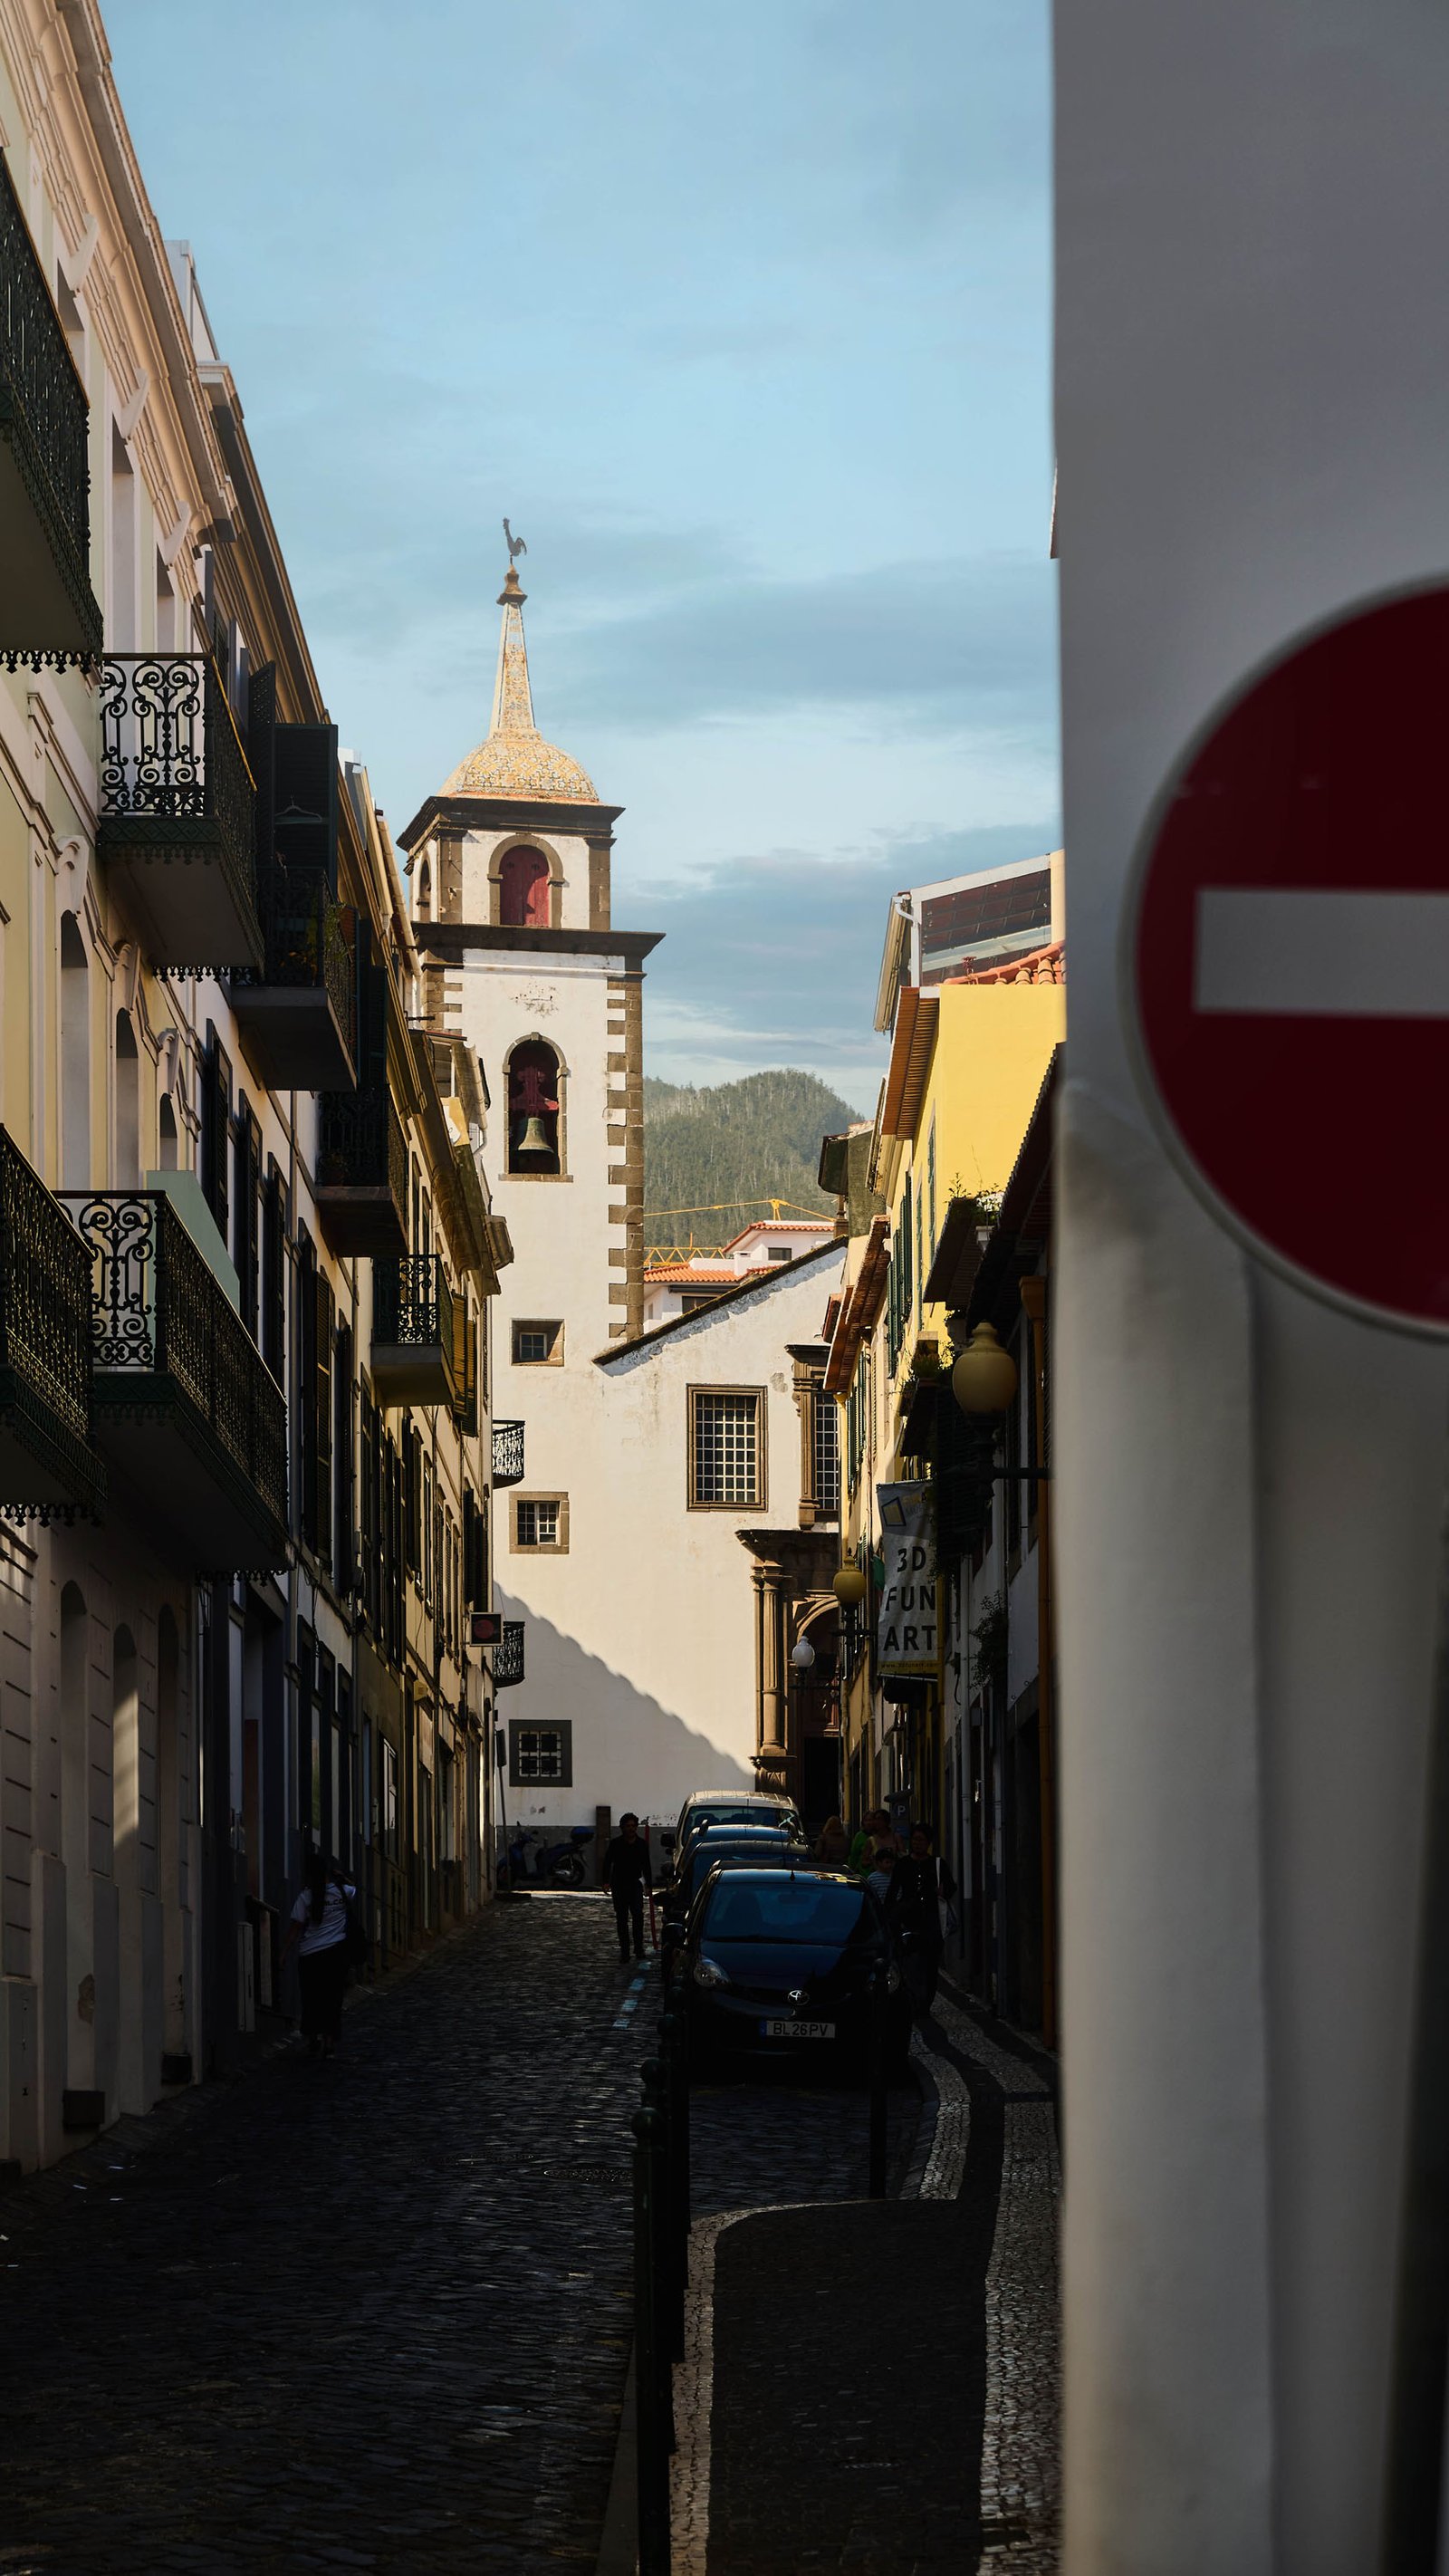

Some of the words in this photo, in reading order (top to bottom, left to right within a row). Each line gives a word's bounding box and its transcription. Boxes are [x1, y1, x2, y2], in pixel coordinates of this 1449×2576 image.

[897, 1546, 926, 1572] 3D
[885, 1585, 936, 1612] FUN
[883, 1625, 937, 1652] ART
[897, 1805, 907, 1817] P
